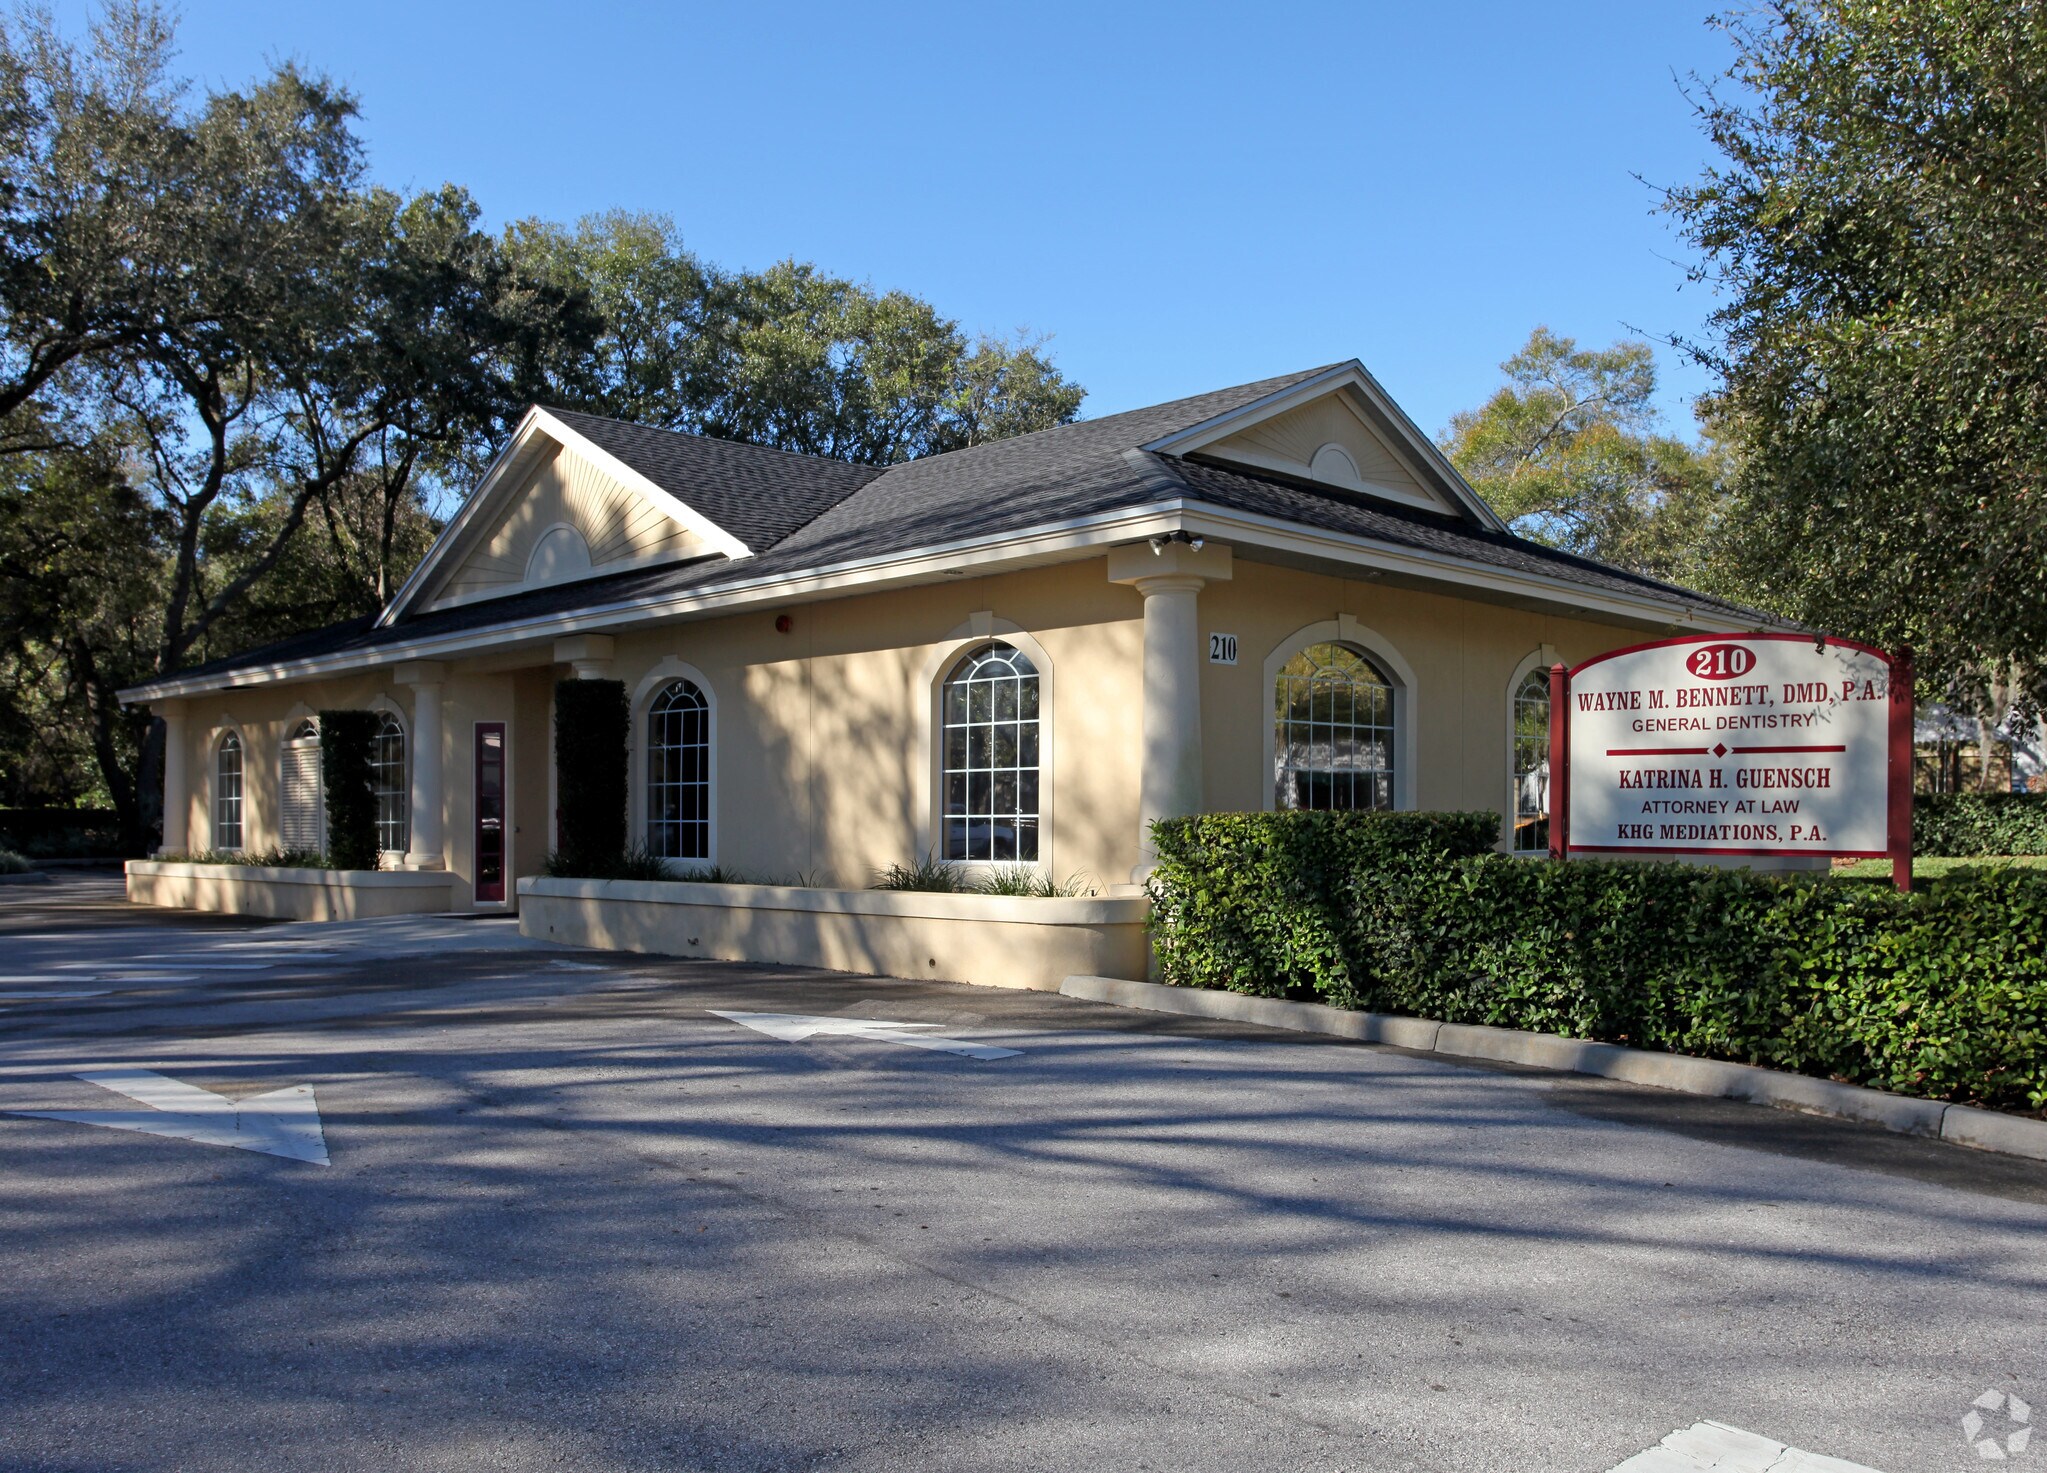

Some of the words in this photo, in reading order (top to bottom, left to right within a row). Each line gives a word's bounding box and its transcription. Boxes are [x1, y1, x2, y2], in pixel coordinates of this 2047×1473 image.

[1211, 635, 1236, 661] 210
[1695, 649, 1747, 676] 210
[1578, 691, 1641, 712] WAYNE
[1649, 689, 1669, 709] M.
[1676, 685, 1774, 708] BENNETT,
[1783, 682, 1834, 706] DMD,
[1842, 680, 1882, 701] P.A.
[1632, 718, 1711, 732] GENERAL
[1716, 713, 1814, 730] DENTISTRY
[1619, 769, 1702, 789] KATRINA
[1709, 768, 1728, 789] H.
[1736, 768, 1831, 788] GUENSCH
[1641, 801, 1728, 814] ATTORNEY
[1735, 801, 1756, 813] AT
[1762, 800, 1800, 813] LAW
[1618, 824, 1654, 840] KHG
[1659, 824, 1783, 843] MEDIATIONS,
[1790, 825, 1827, 841] P.A.
